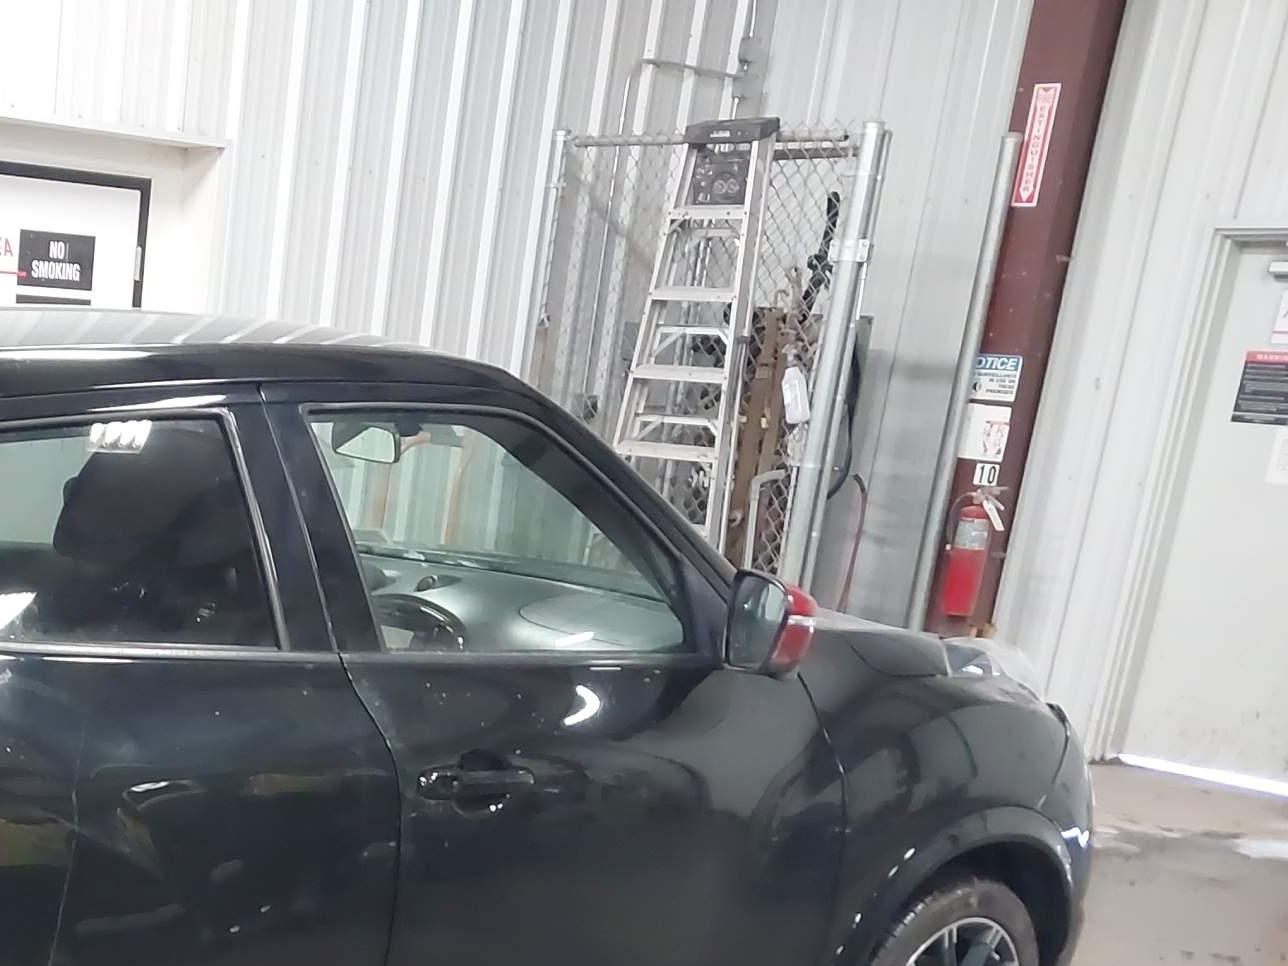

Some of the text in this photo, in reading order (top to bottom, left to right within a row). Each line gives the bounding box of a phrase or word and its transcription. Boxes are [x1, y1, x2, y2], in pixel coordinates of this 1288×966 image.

[49, 240, 65, 259] NO
[31, 260, 81, 281] SMOKING
[975, 357, 1018, 370] OTICE
[978, 465, 997, 484] 10
